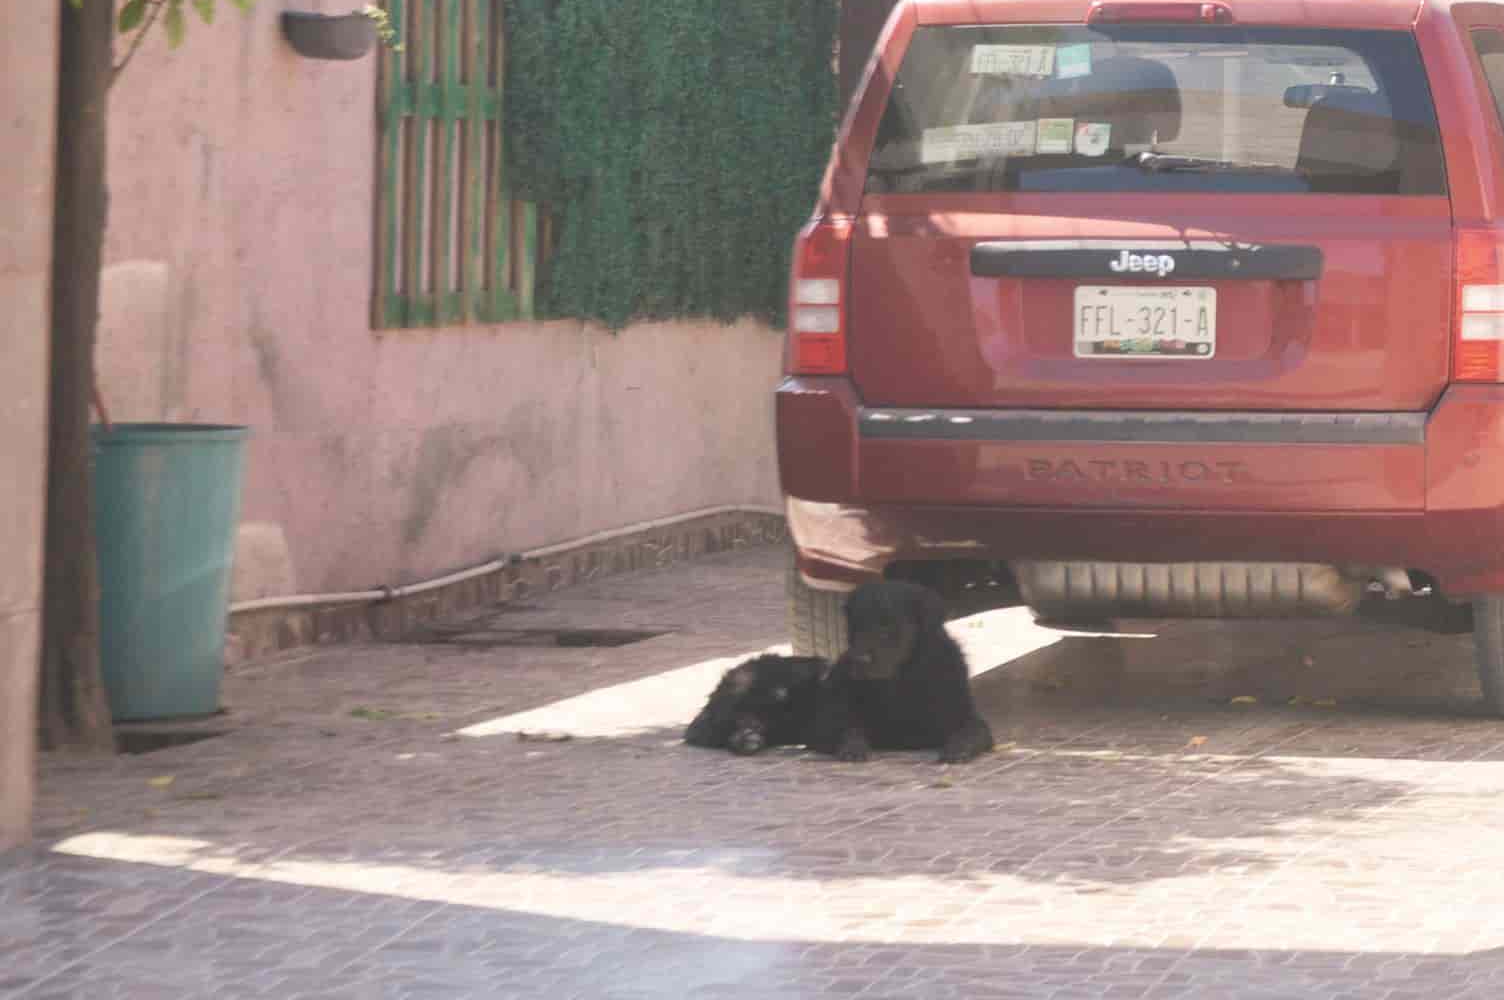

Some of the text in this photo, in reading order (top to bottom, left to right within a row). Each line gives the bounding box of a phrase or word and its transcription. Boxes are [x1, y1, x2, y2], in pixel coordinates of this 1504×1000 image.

[1109, 250, 1176, 278] Jeep
[1080, 304, 1209, 336] FFL-321-A
[1024, 456, 1248, 484] PATRIOT
